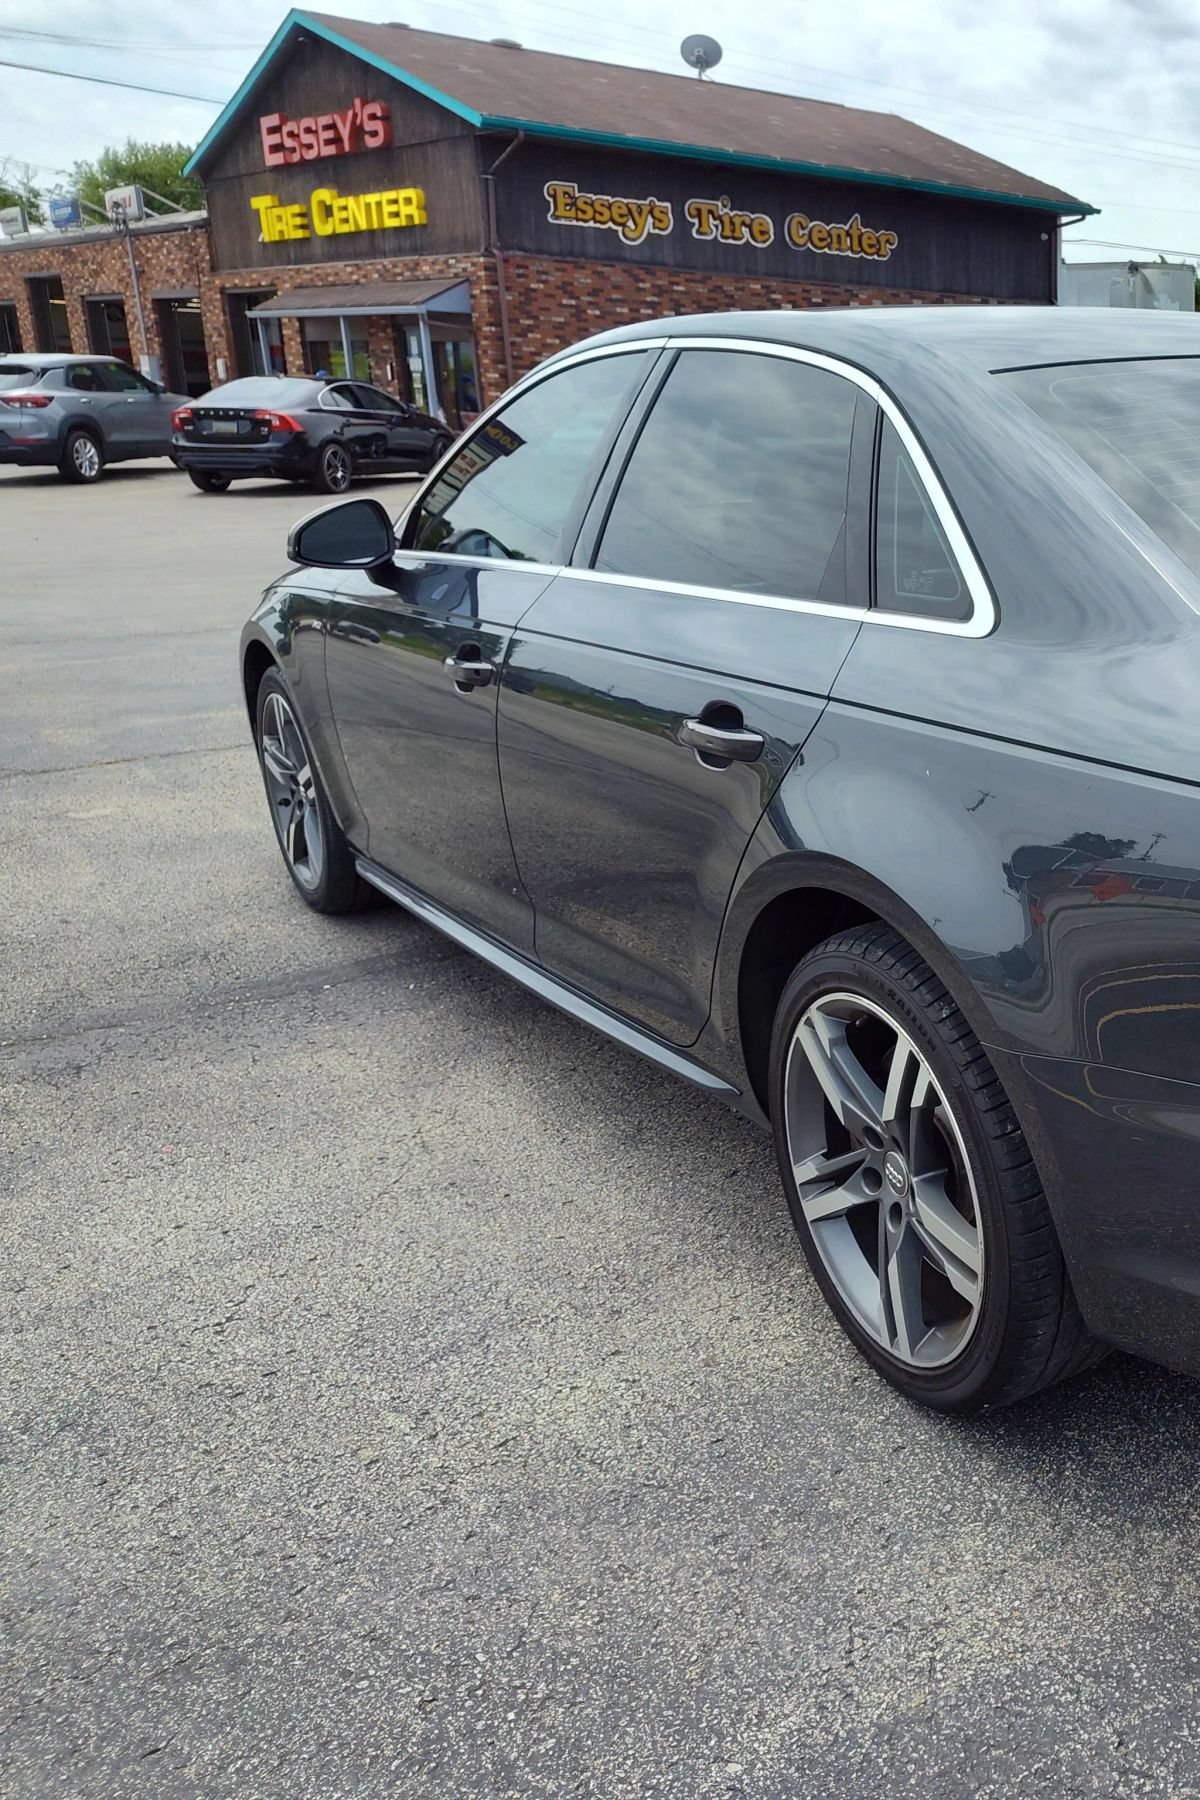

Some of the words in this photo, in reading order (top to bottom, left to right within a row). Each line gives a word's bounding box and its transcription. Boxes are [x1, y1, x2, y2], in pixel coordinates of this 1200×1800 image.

[260, 97, 391, 167] ESSEY'S
[250, 195, 311, 242] TIRE
[311, 188, 427, 236] CENTER
[545, 181, 673, 245] Essey's
[686, 196, 773, 248] Tire
[787, 214, 897, 260] Center
